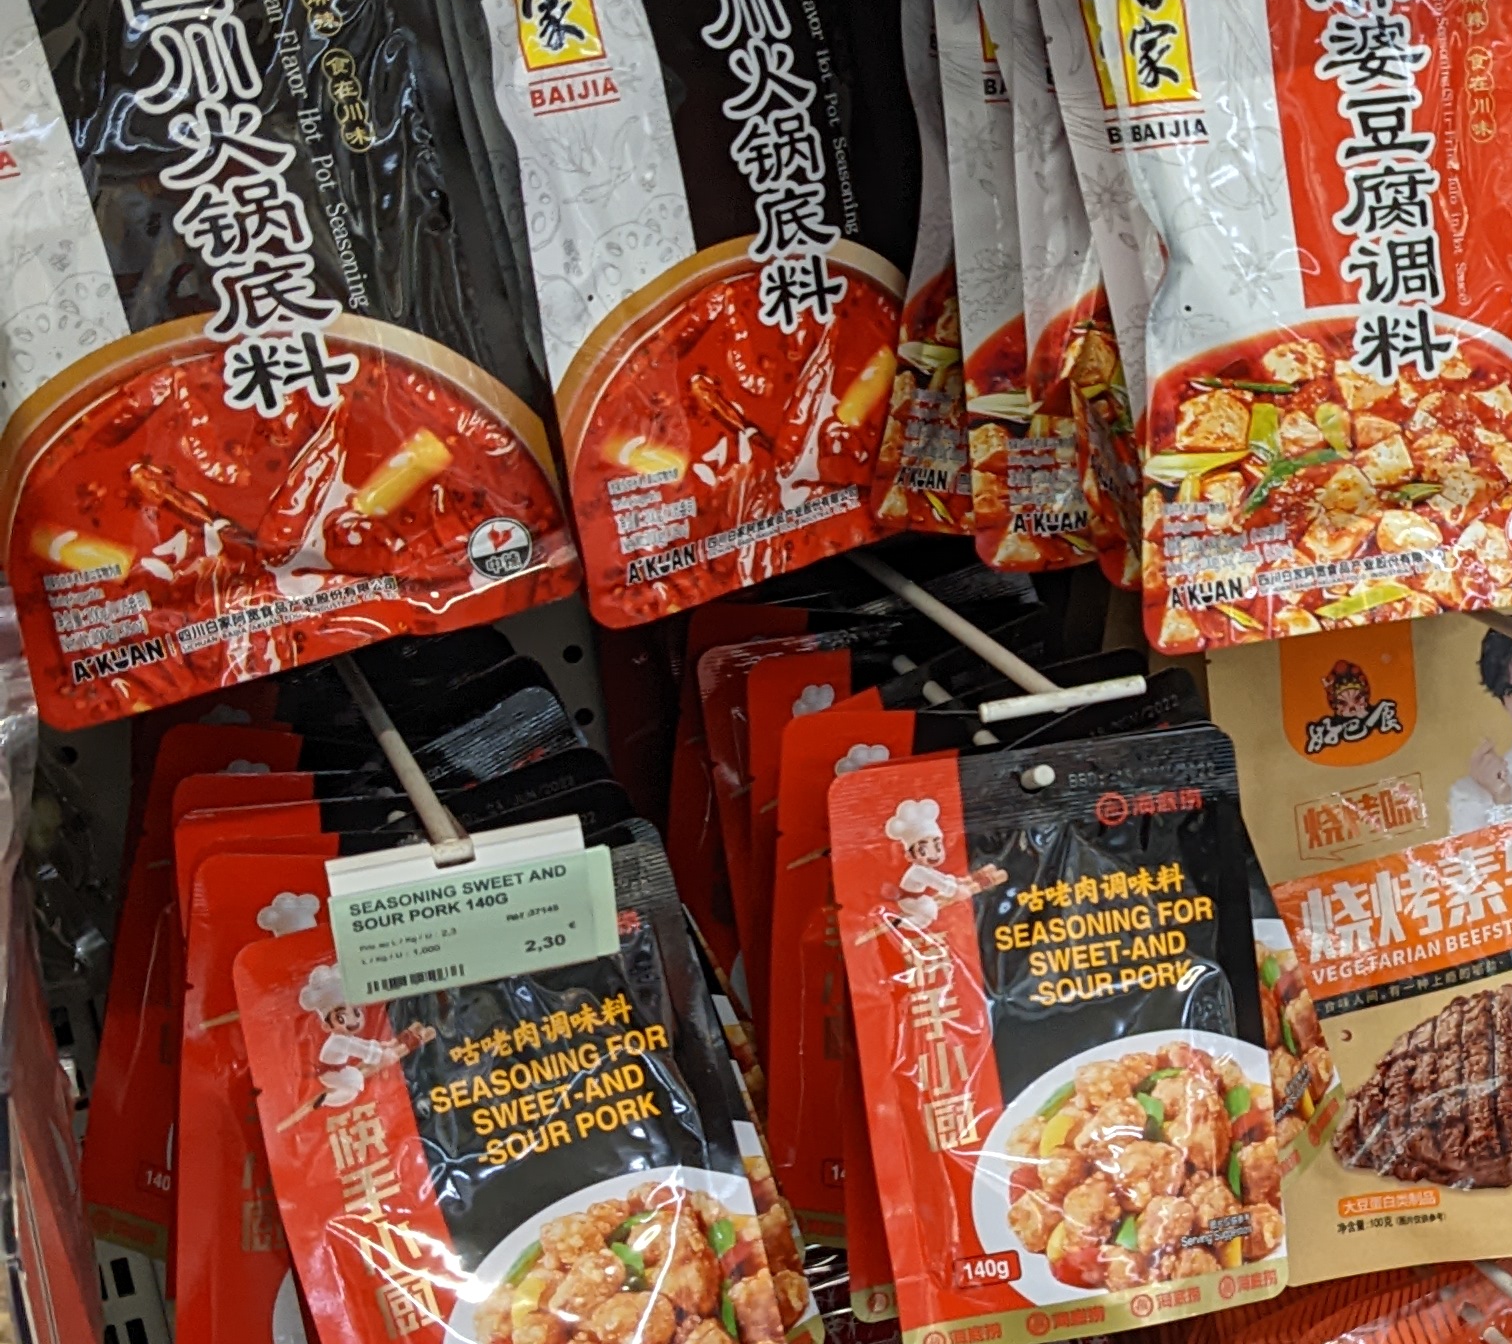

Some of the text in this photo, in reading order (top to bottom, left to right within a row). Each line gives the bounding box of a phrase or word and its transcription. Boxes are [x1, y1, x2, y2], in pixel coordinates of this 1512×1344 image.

[529, 77, 620, 111] BAIJIA
[1131, 117, 1208, 145] BAIJIA
[349, 863, 568, 917] SEASONING SWEET AND
[352, 891, 509, 934] SOUR PORK 140G
[524, 932, 567, 953] 2,30
[993, 895, 1215, 953] SEASONING FOR
[1028, 932, 1187, 979] SWEET-AND
[1310, 940, 1442, 987] VEGETARIAN
[429, 1023, 670, 1116] SEASONING FOR
[471, 1061, 647, 1138] SWEET-AND
[476, 1092, 664, 1167] -SOUR PORK
[961, 1259, 1011, 1283] 140g
